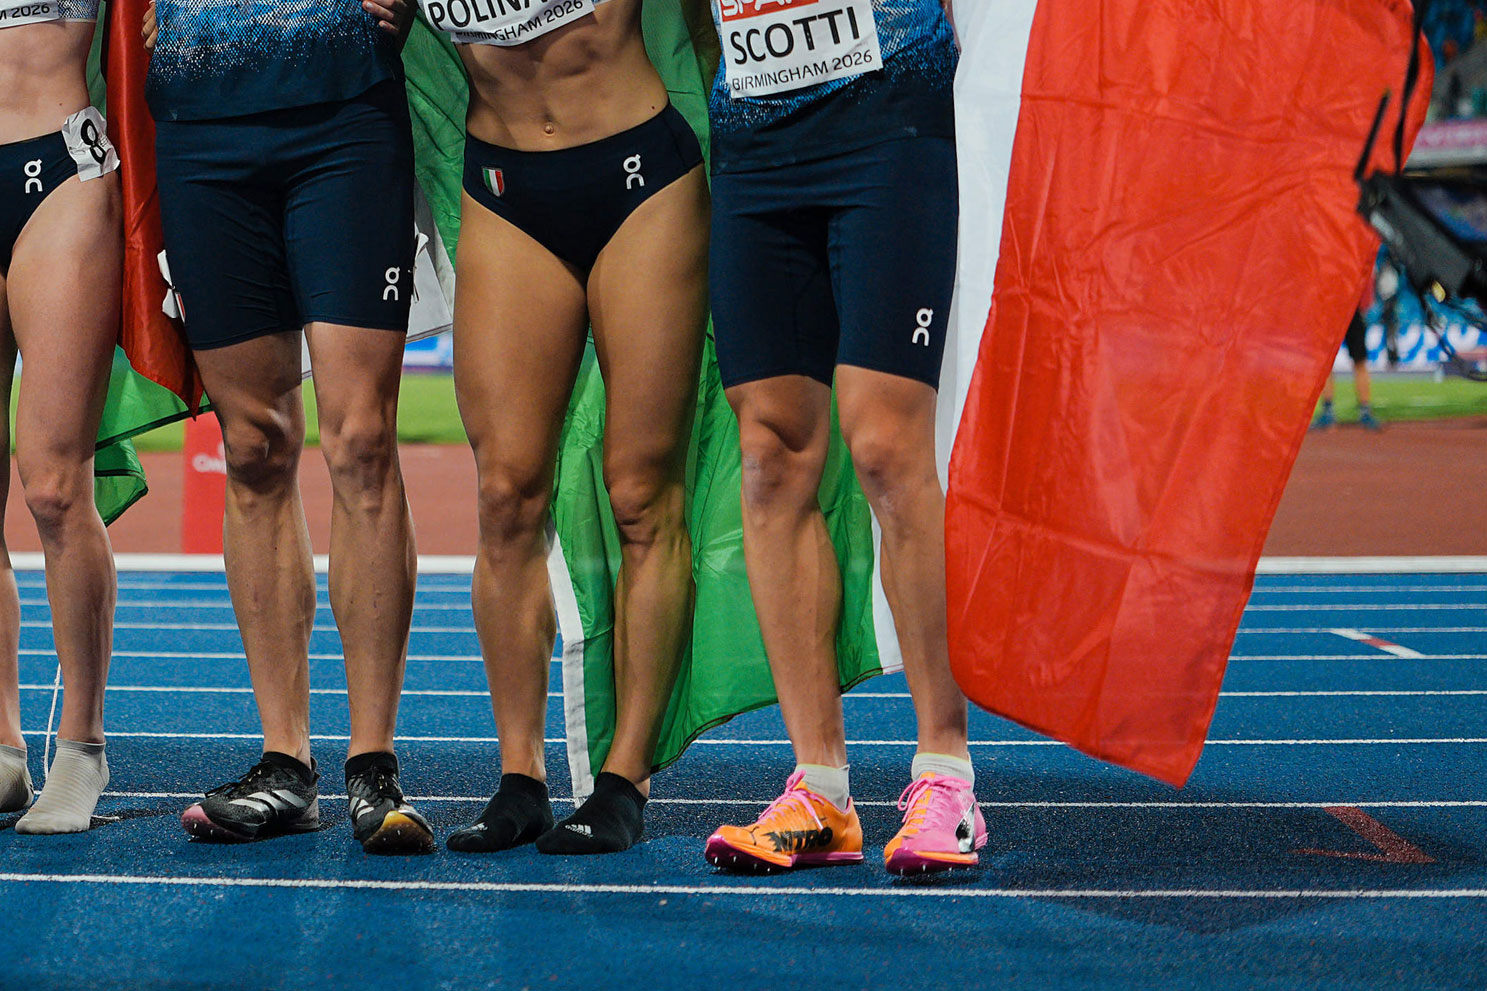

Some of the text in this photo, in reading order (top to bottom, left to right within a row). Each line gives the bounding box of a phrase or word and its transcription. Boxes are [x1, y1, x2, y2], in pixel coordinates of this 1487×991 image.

[11, 3, 50, 18] 2026
[730, 6, 860, 65] SCOTTI
[732, 49, 873, 91] BIRMINGHAM 2026
